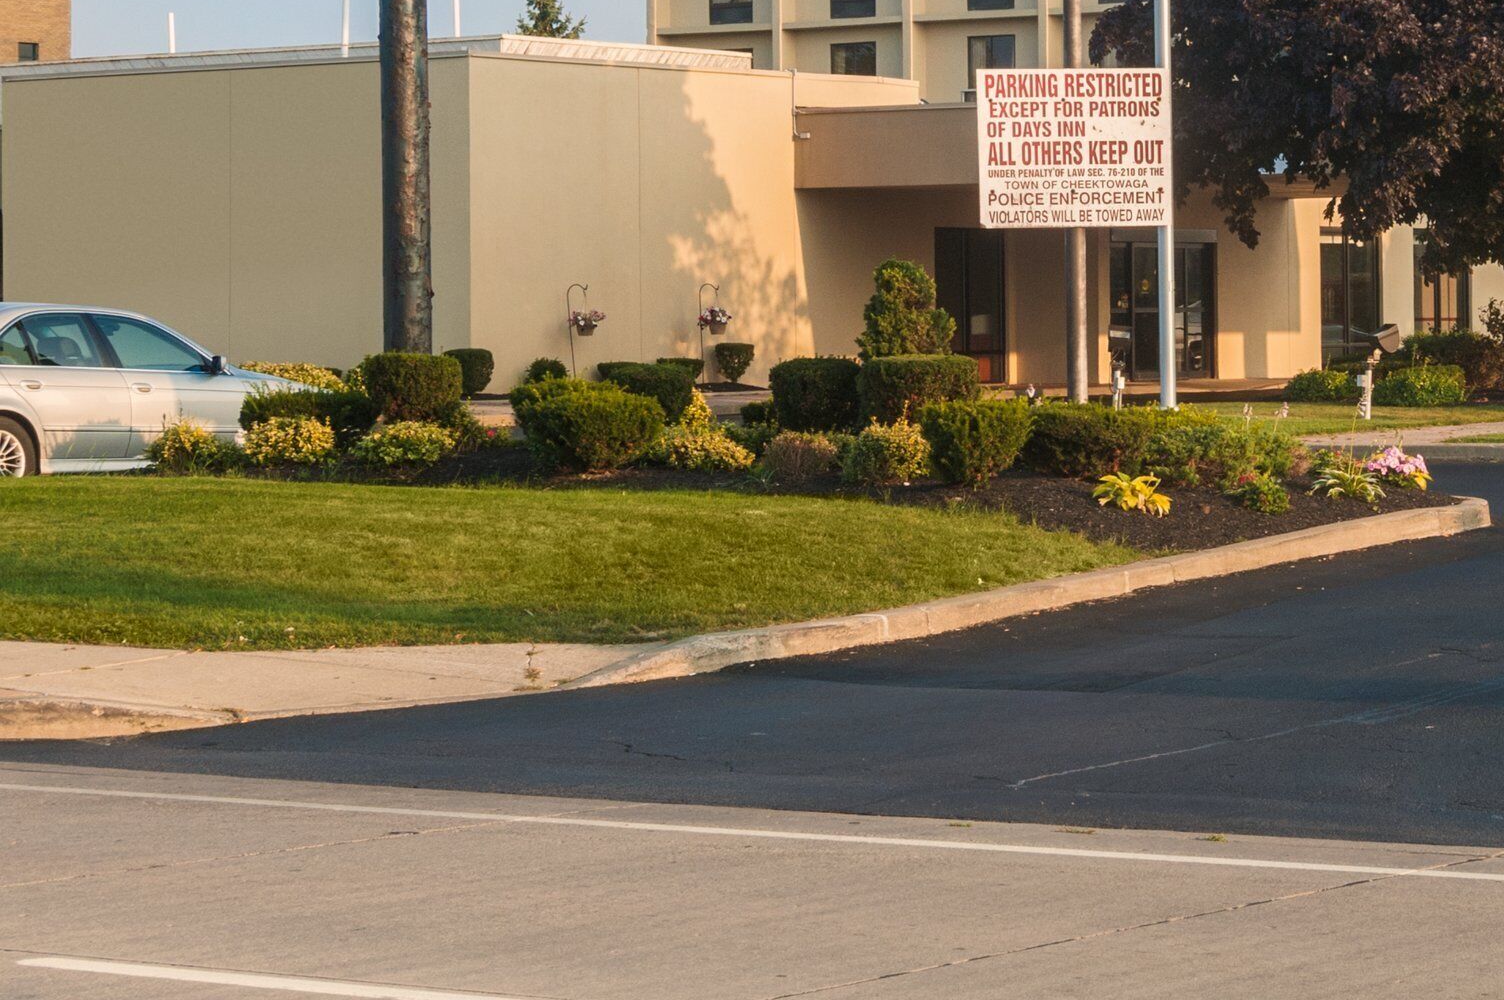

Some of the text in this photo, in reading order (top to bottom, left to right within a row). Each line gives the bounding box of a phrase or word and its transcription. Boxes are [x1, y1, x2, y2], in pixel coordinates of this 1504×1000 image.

[984, 73, 1162, 98] PARKING RESTRICTED
[989, 100, 1160, 118] EXCEPT FOR PATRONS
[987, 121, 1086, 138] OF DAYS INN
[988, 140, 1163, 166] ALL OTHERS KEEP OUT
[988, 167, 1164, 178] UNDER PENALTY OF LAW SEC. 76-210 OF THE
[1005, 179, 1148, 190] TOWN OF CHEEKTOWAGA
[988, 191, 1163, 206] POLICE ENFORCEMENT
[989, 209, 1165, 224] VIOLATORS WILL BE TOWED AWAY
